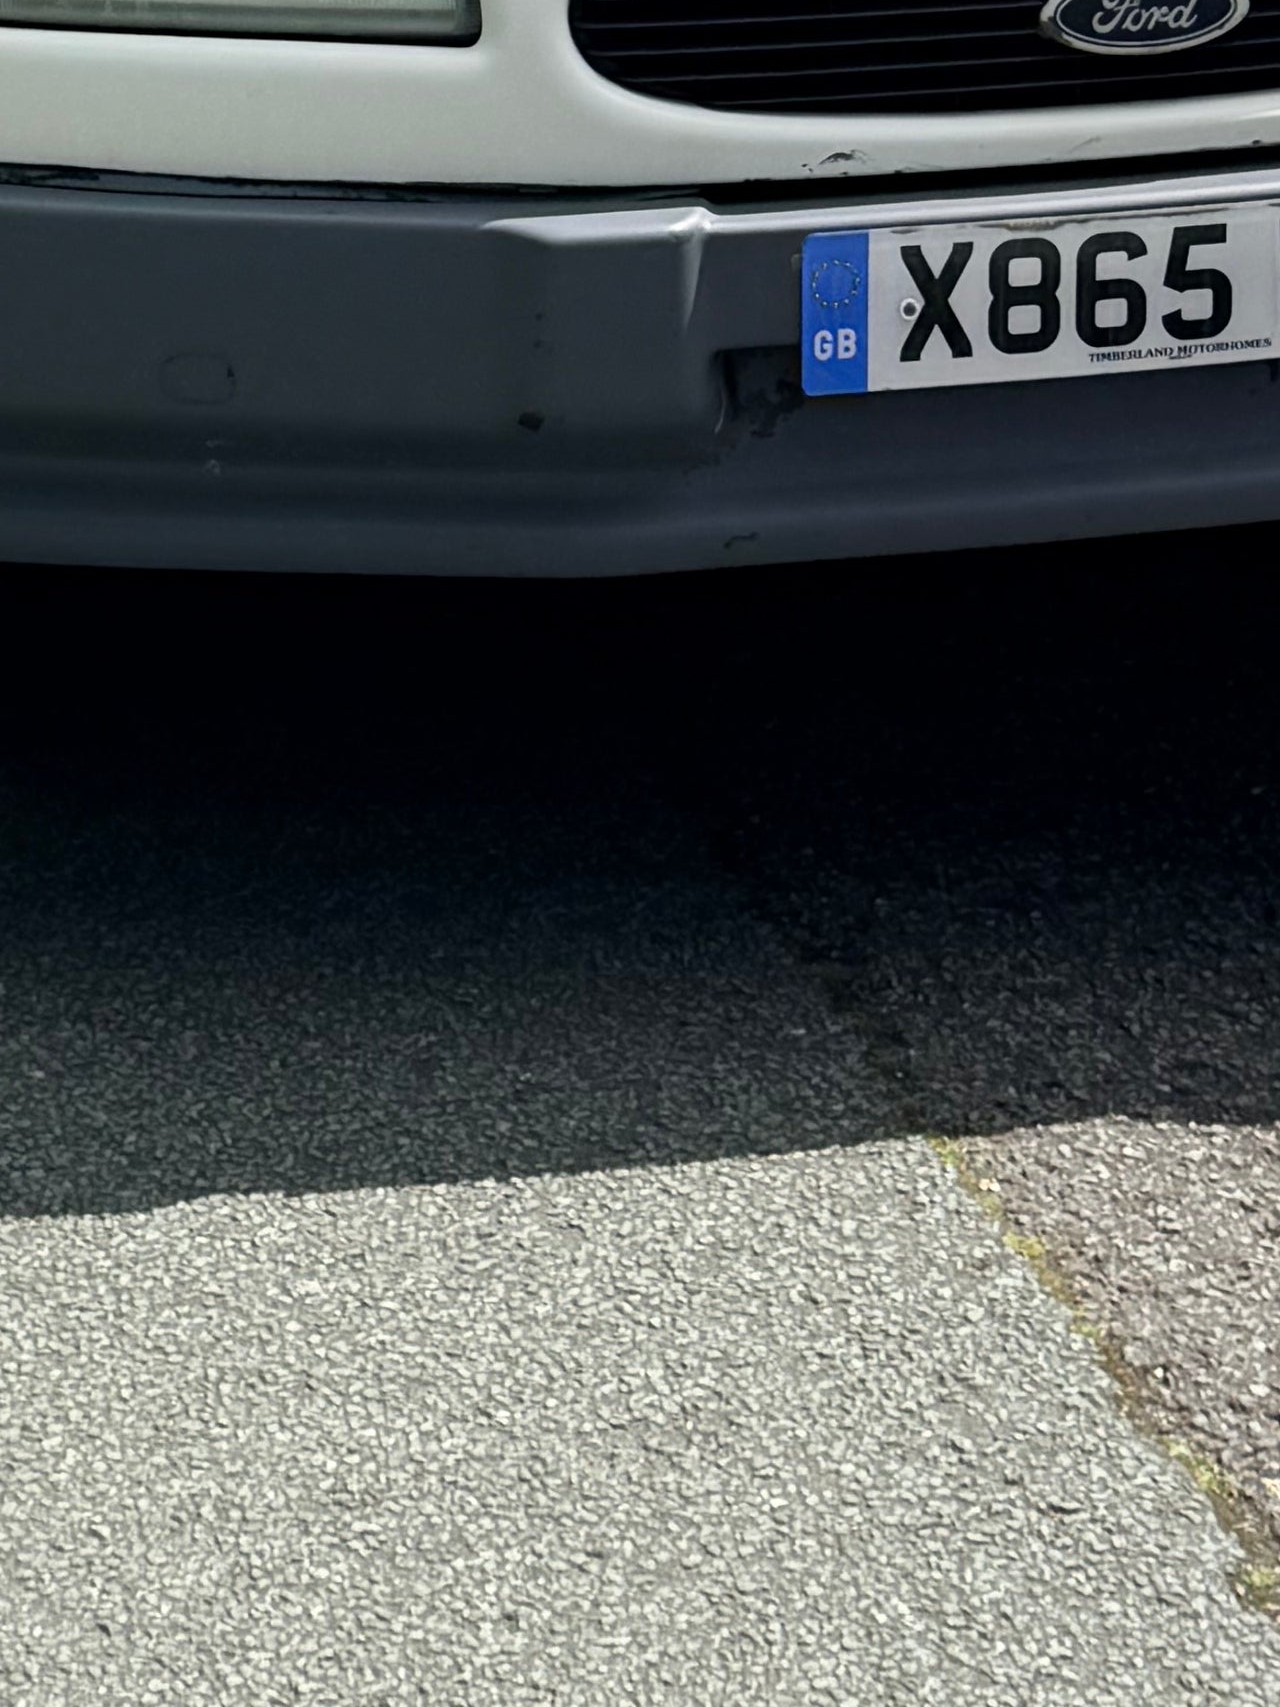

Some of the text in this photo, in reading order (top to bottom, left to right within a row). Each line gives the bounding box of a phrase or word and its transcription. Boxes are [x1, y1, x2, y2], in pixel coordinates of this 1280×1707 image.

[898, 222, 1234, 363] X865
[813, 329, 858, 362] GB
[1087, 337, 1272, 363] TIMBERLAND MOTORHOMES
